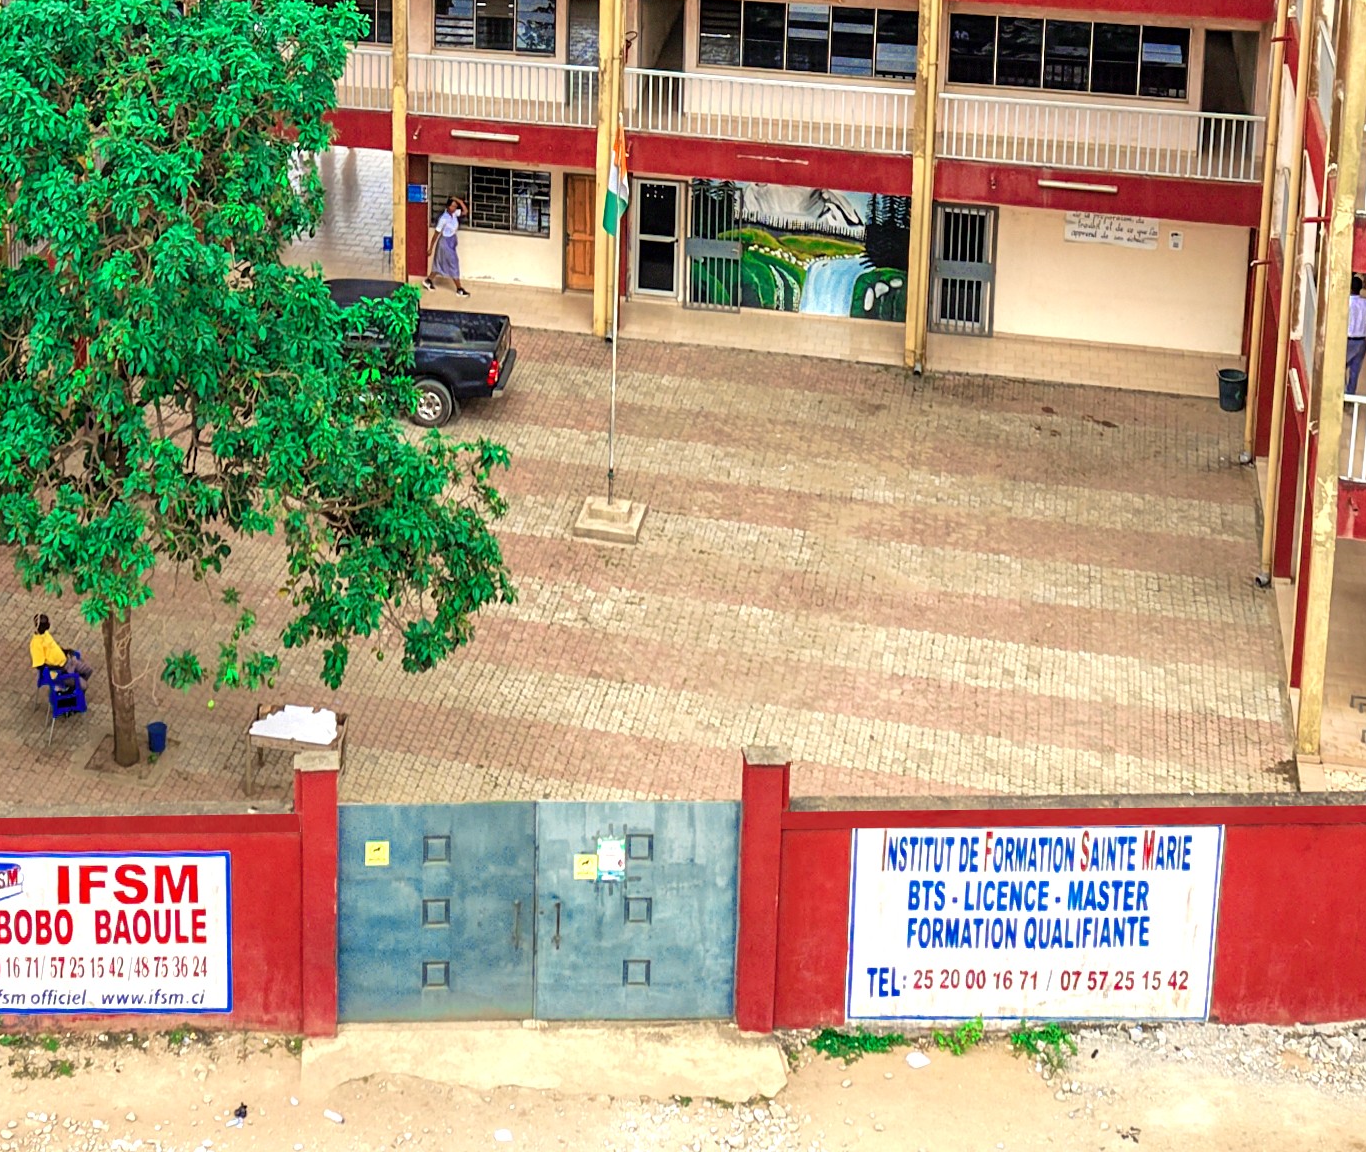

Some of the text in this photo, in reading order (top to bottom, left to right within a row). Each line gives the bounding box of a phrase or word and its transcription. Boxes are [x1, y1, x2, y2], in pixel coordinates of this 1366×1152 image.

[881, 829, 1192, 873] INSTITUT DE FORMATION SAINTE MARIE
[57, 864, 198, 905] IFSM
[908, 880, 945, 911] BTS
[964, 880, 1049, 912] LICENCE
[1067, 880, 1149, 912] MASTER
[95, 908, 207, 944] BAOULE
[907, 916, 1150, 950] FORMATION QUALIFIANTE
[6, 957, 20, 977] 16
[51, 957, 65, 978] 57
[70, 957, 84, 978] 25
[91, 957, 104, 978] 15
[109, 957, 123, 977] 42
[154, 956, 168, 977] 75
[173, 956, 188, 977] 36
[193, 956, 207, 977] 24
[867, 967, 906, 997] TEL:
[913, 970, 933, 989] 25
[940, 969, 960, 989] 20
[966, 969, 986, 989] 00
[993, 970, 1012, 989] 16
[1020, 971, 1037, 990] 71
[1061, 970, 1081, 991] 07
[1088, 971, 1108, 992] 57
[1114, 971, 1134, 990] 25
[1143, 971, 1161, 990] 15
[1168, 971, 1188, 990] 42
[31, 990, 86, 1005] officiel
[102, 989, 204, 1004] www.ifsm.ci
